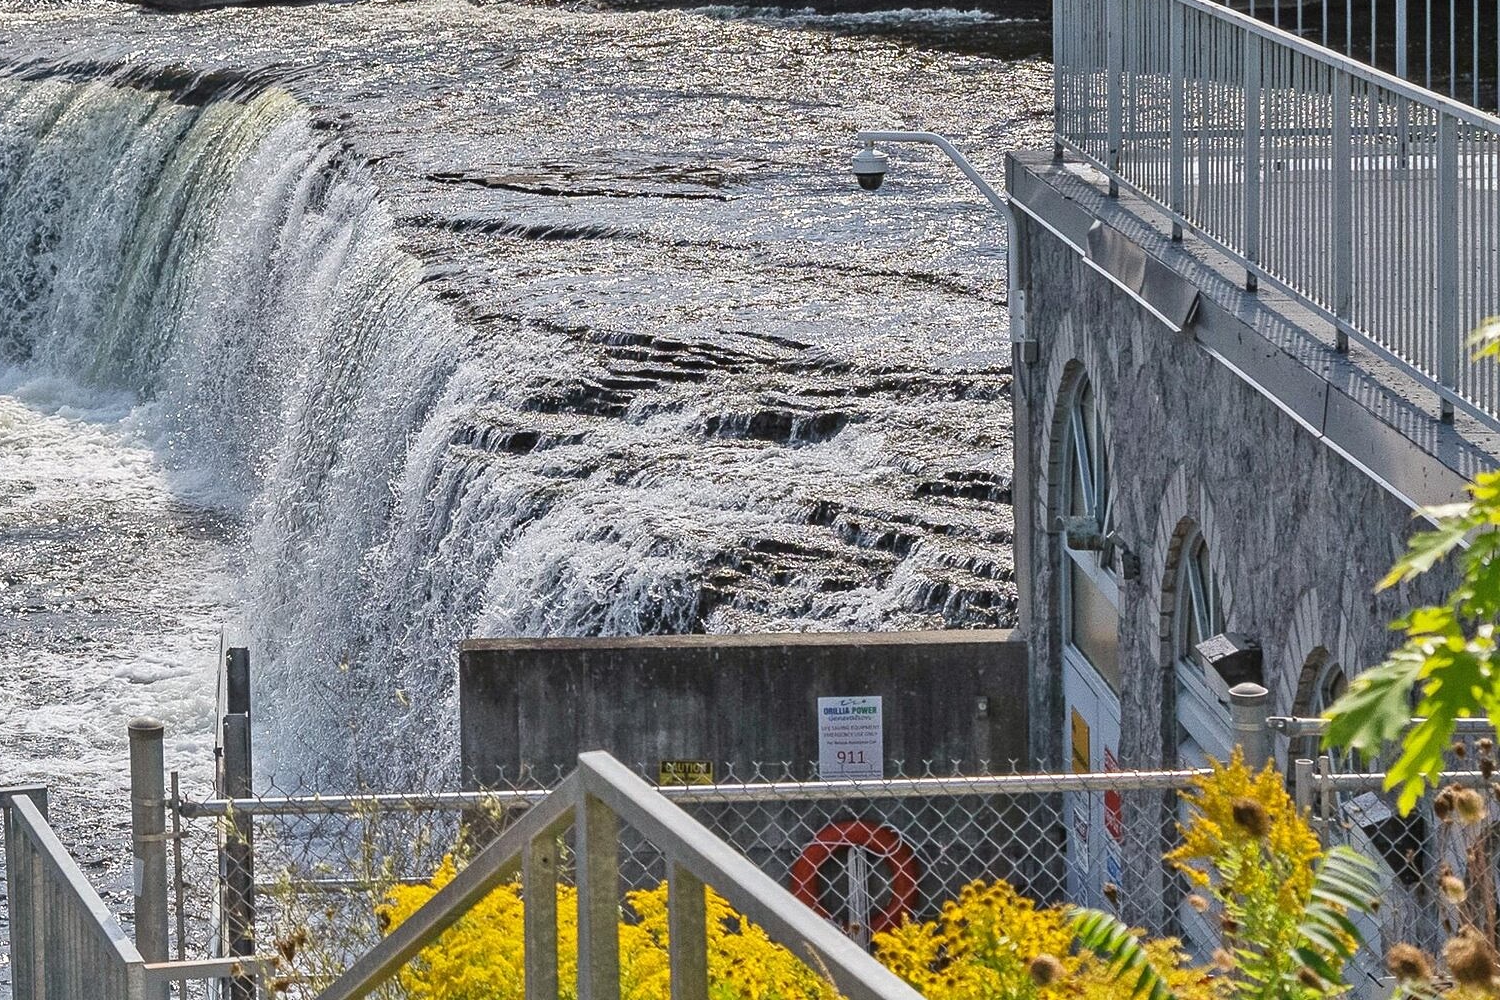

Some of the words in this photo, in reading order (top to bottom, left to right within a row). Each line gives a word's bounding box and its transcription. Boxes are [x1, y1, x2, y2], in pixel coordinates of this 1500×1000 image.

[823, 707, 850, 715] ORILLIA
[851, 706, 877, 714] POWER
[837, 750, 866, 764] 911
